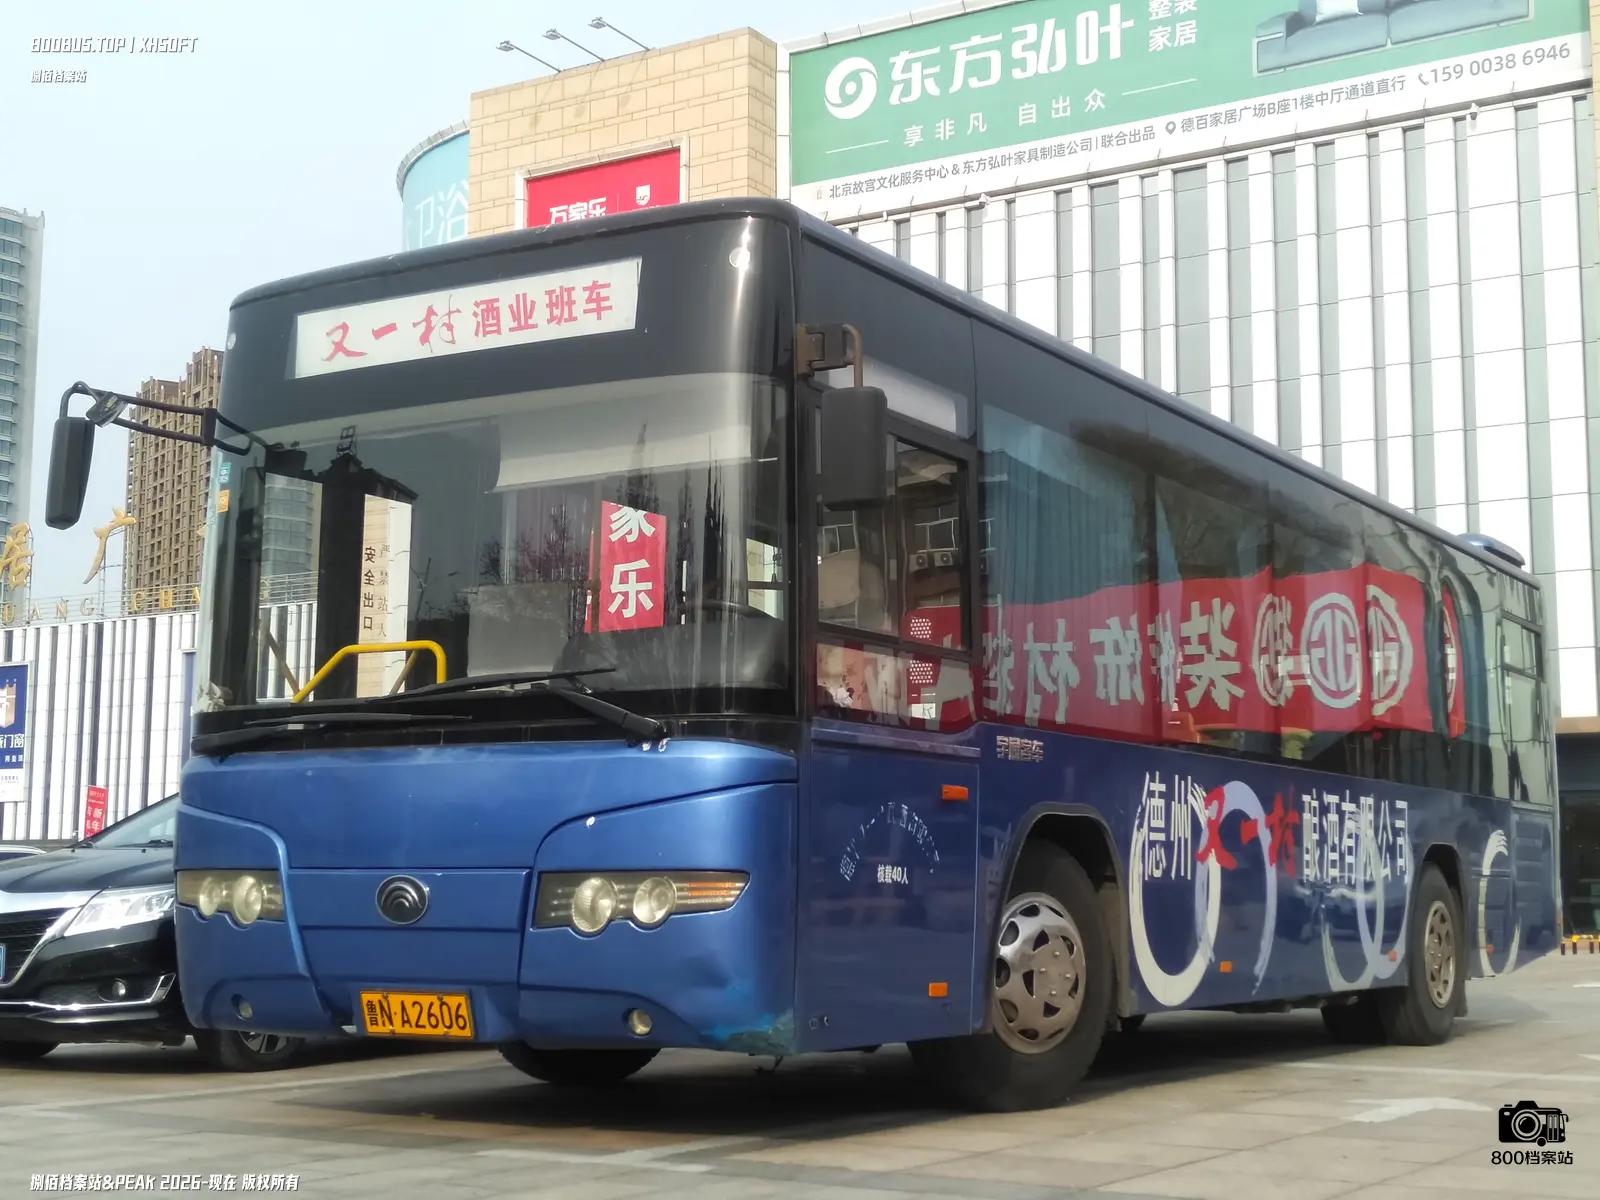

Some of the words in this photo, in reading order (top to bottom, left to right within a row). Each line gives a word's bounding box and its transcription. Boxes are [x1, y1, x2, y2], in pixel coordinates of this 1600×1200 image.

[887, 3, 1135, 106] 东方弘叶
[1148, 19, 1199, 53] 家居
[1430, 63, 1464, 84] 159
[1469, 53, 1517, 76] 0038
[1522, 42, 1571, 66] 6946
[1180, 74, 1407, 133] 德百家居广场B座1楼中厅通道直行
[363, 545, 377, 631] 安全出口
[606, 502, 656, 619] 家乐
[877, 864, 909, 884] 核载40人
